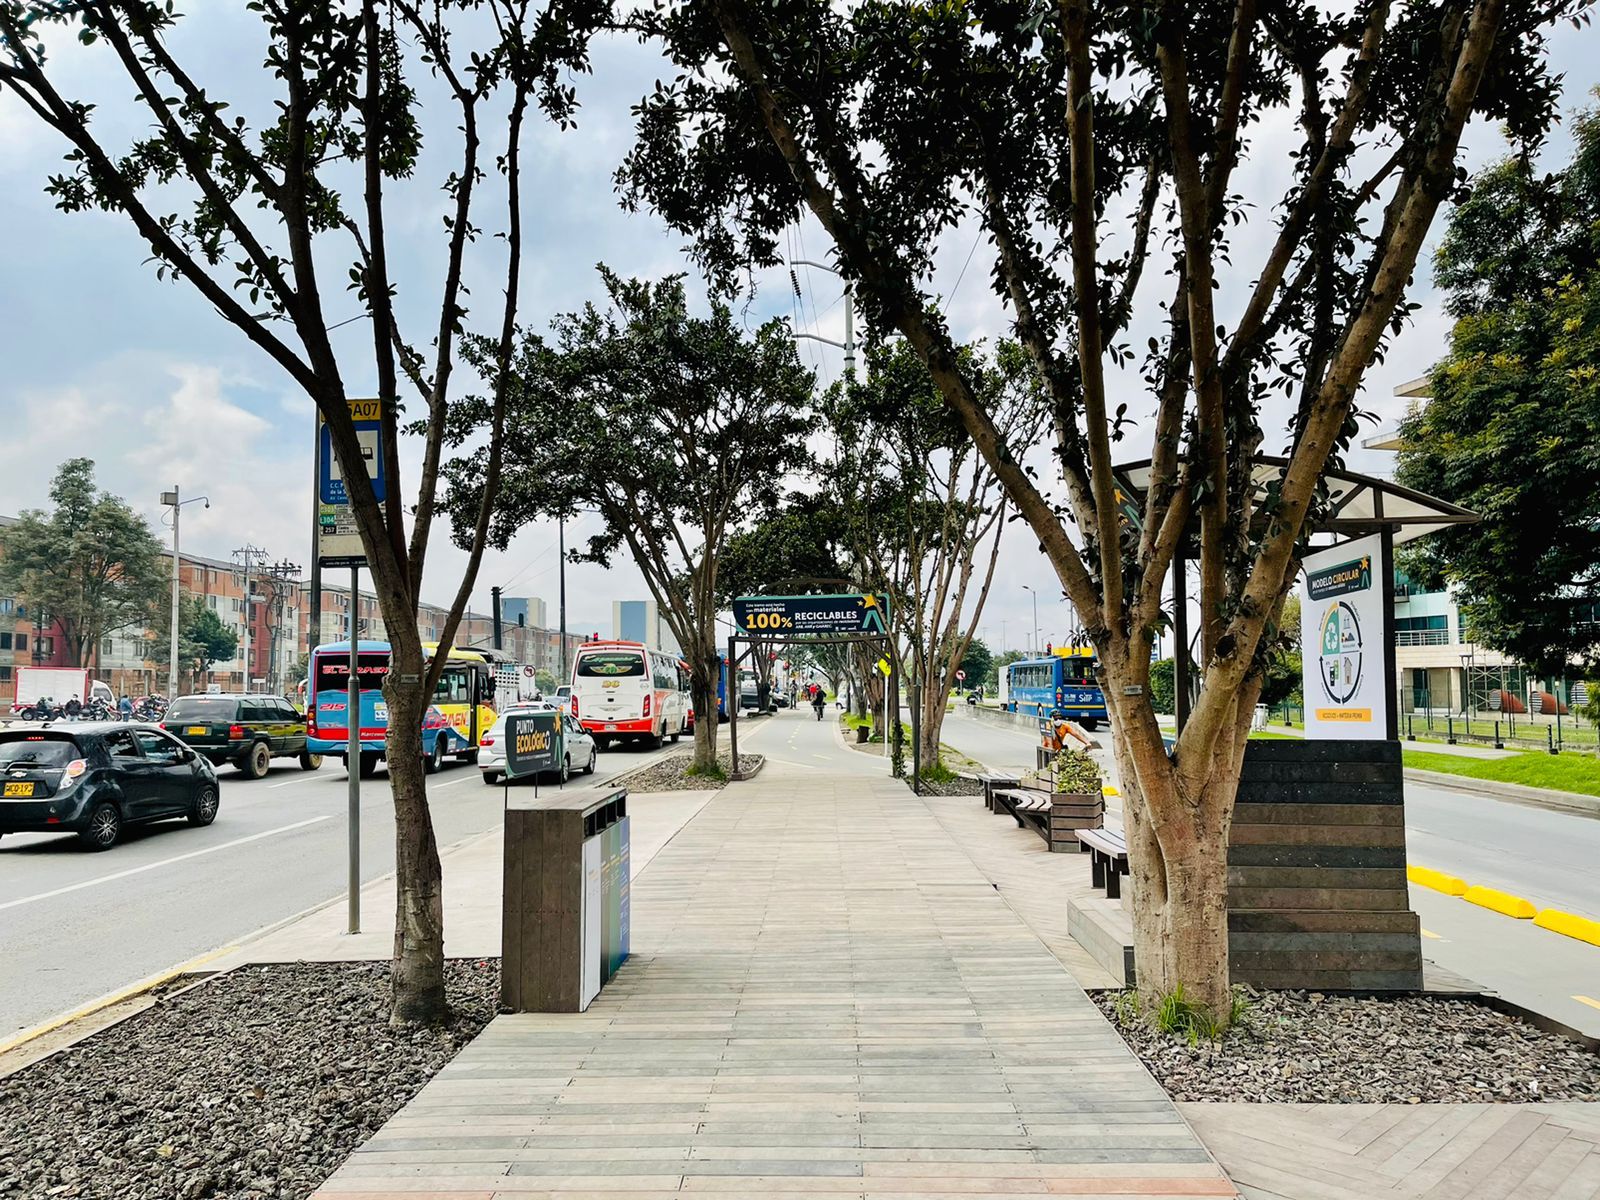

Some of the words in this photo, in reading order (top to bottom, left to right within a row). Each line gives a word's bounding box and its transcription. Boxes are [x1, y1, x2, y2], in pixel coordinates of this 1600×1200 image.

[1312, 576, 1332, 590] MODELO
[1333, 569, 1360, 584] CIRCULAR
[746, 613, 793, 629] 100%
[795, 611, 858, 620] RECICLABLES
[319, 703, 346, 711] 215
[516, 719, 534, 734] PUNTO
[516, 730, 551, 754] ECOLÓGICO
